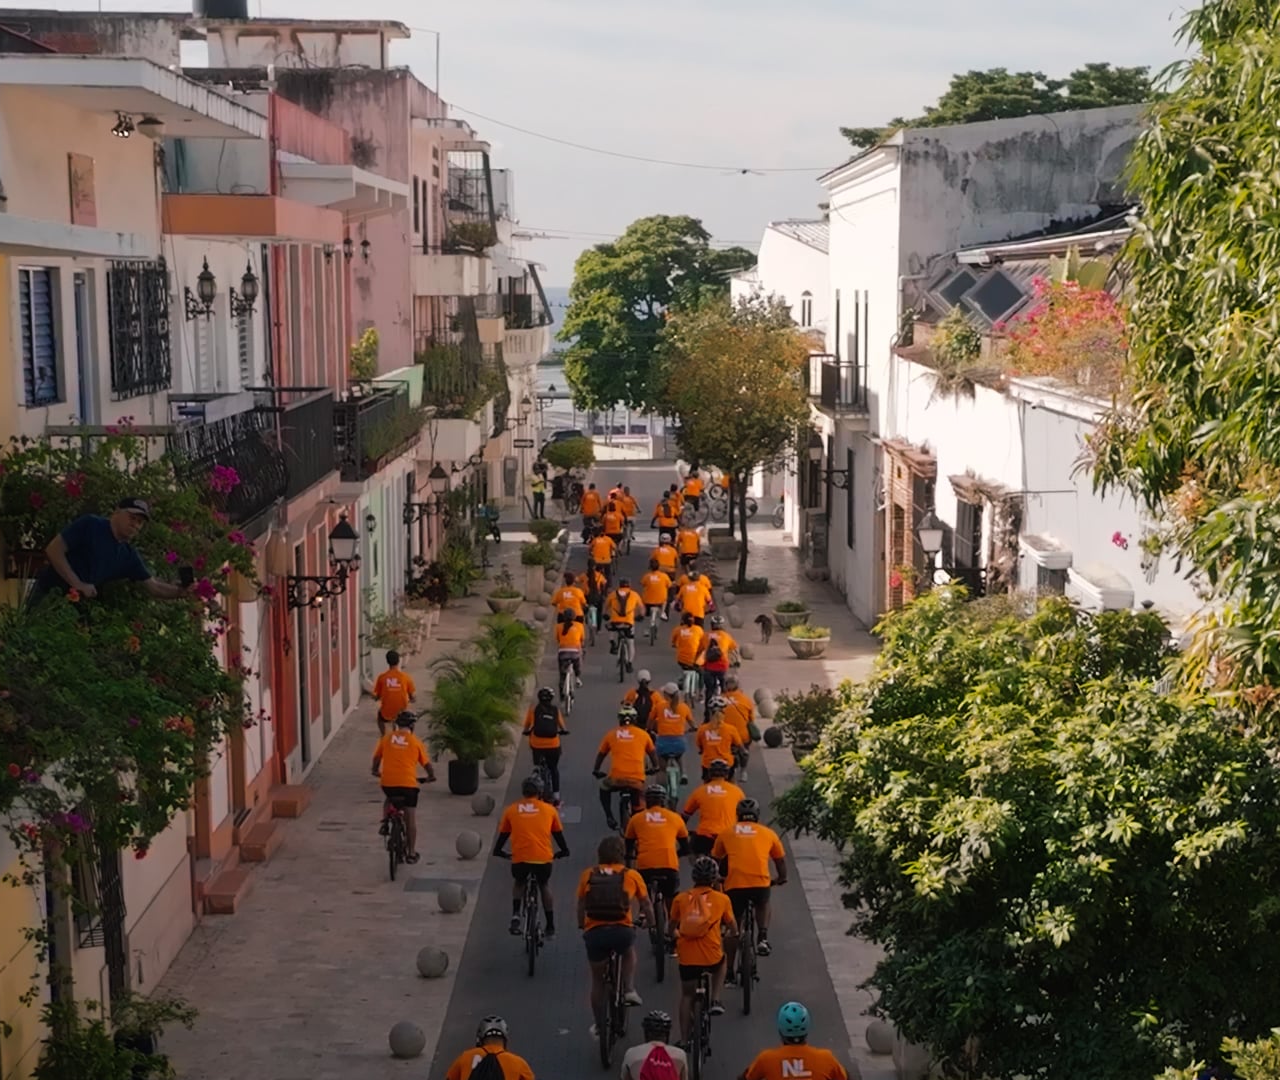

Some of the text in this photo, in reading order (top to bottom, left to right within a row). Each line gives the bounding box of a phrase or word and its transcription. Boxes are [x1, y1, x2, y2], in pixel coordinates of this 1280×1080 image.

[391, 734, 409, 745] NL
[616, 730, 635, 739] NL
[517, 803, 539, 813] NL
[645, 812, 667, 823] NL
[735, 825, 757, 835] NL
[782, 1058, 812, 1078] NL
